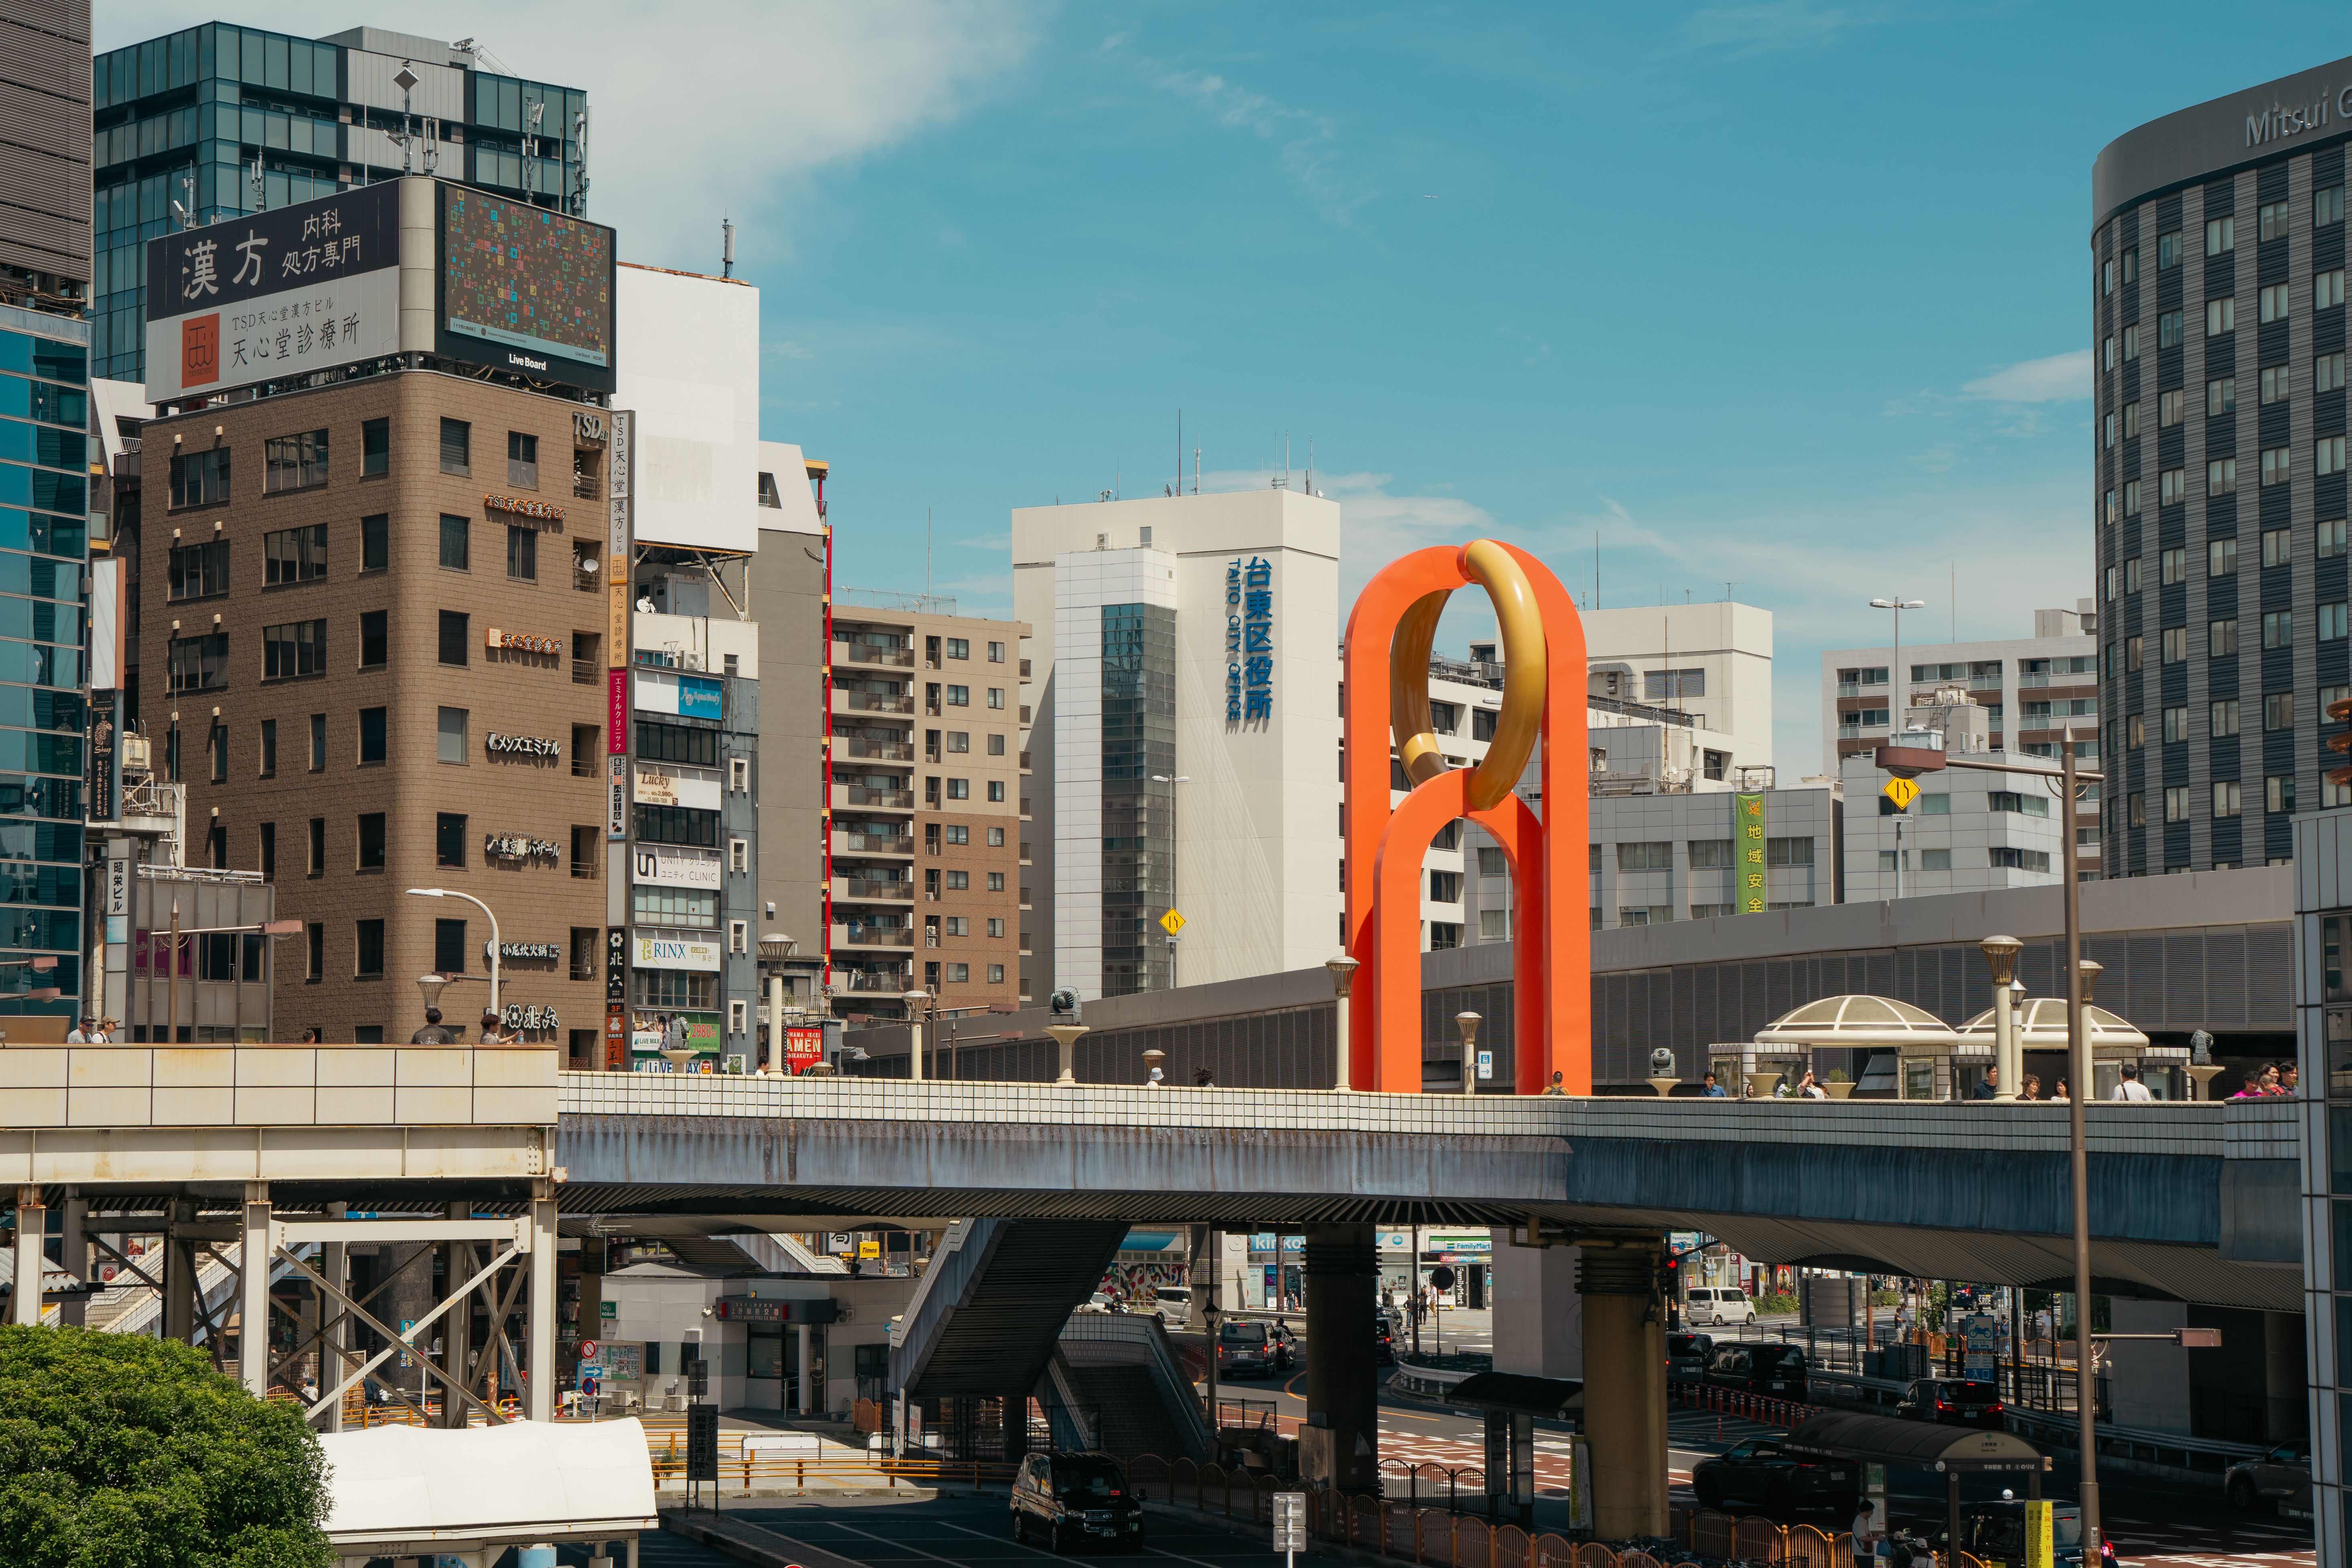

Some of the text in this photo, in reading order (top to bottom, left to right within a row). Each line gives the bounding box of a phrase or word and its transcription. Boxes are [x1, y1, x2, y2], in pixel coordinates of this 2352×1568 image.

[2246, 91, 2329, 147] Mitsui
[302, 208, 341, 241] 内科
[183, 229, 269, 300] 漢方
[282, 235, 360, 278] 処方専門
[232, 296, 334, 331] TSD天心堂漢方ビル
[231, 312, 360, 368] 天心堂診療所
[188, 367, 213, 378] TENSHINDO
[509, 353, 547, 371] Live Board
[573, 411, 602, 439] TSD
[488, 495, 566, 520] TSD天心堂漢方ビル
[614, 587, 624, 663] 天心堂診療所
[504, 634, 563, 655] 天心堂診療所
[1228, 558, 1241, 721] TAITO CITY OFFICE
[1244, 556, 1273, 720] 台東区役所
[94, 746, 112, 754] Sheep
[498, 735, 561, 756] メンズエミナル
[641, 771, 670, 789] Lucky
[661, 855, 717, 867] UNITY クリニック
[1747, 824, 1763, 912] 地域安全
[113, 862, 123, 912] 昭栄ビル
[661, 871, 716, 882] ユニティ CLINIC
[502, 943, 547, 957] 小龙坎火锅
[654, 942, 686, 959] RINX
[610, 952, 623, 988] 北六
[524, 1005, 560, 1029] 北六
[608, 1041, 618, 1062] 三羊
[687, 1063, 700, 1074] AX
[731, 1307, 779, 1316] 上野駅前交番
[1978, 1297, 1991, 1305] S.RIDE
[1968, 1318, 1975, 1327] P
[1972, 1369, 1990, 1380] 入口
[694, 1410, 707, 1477] 一般車両は通行禁止
